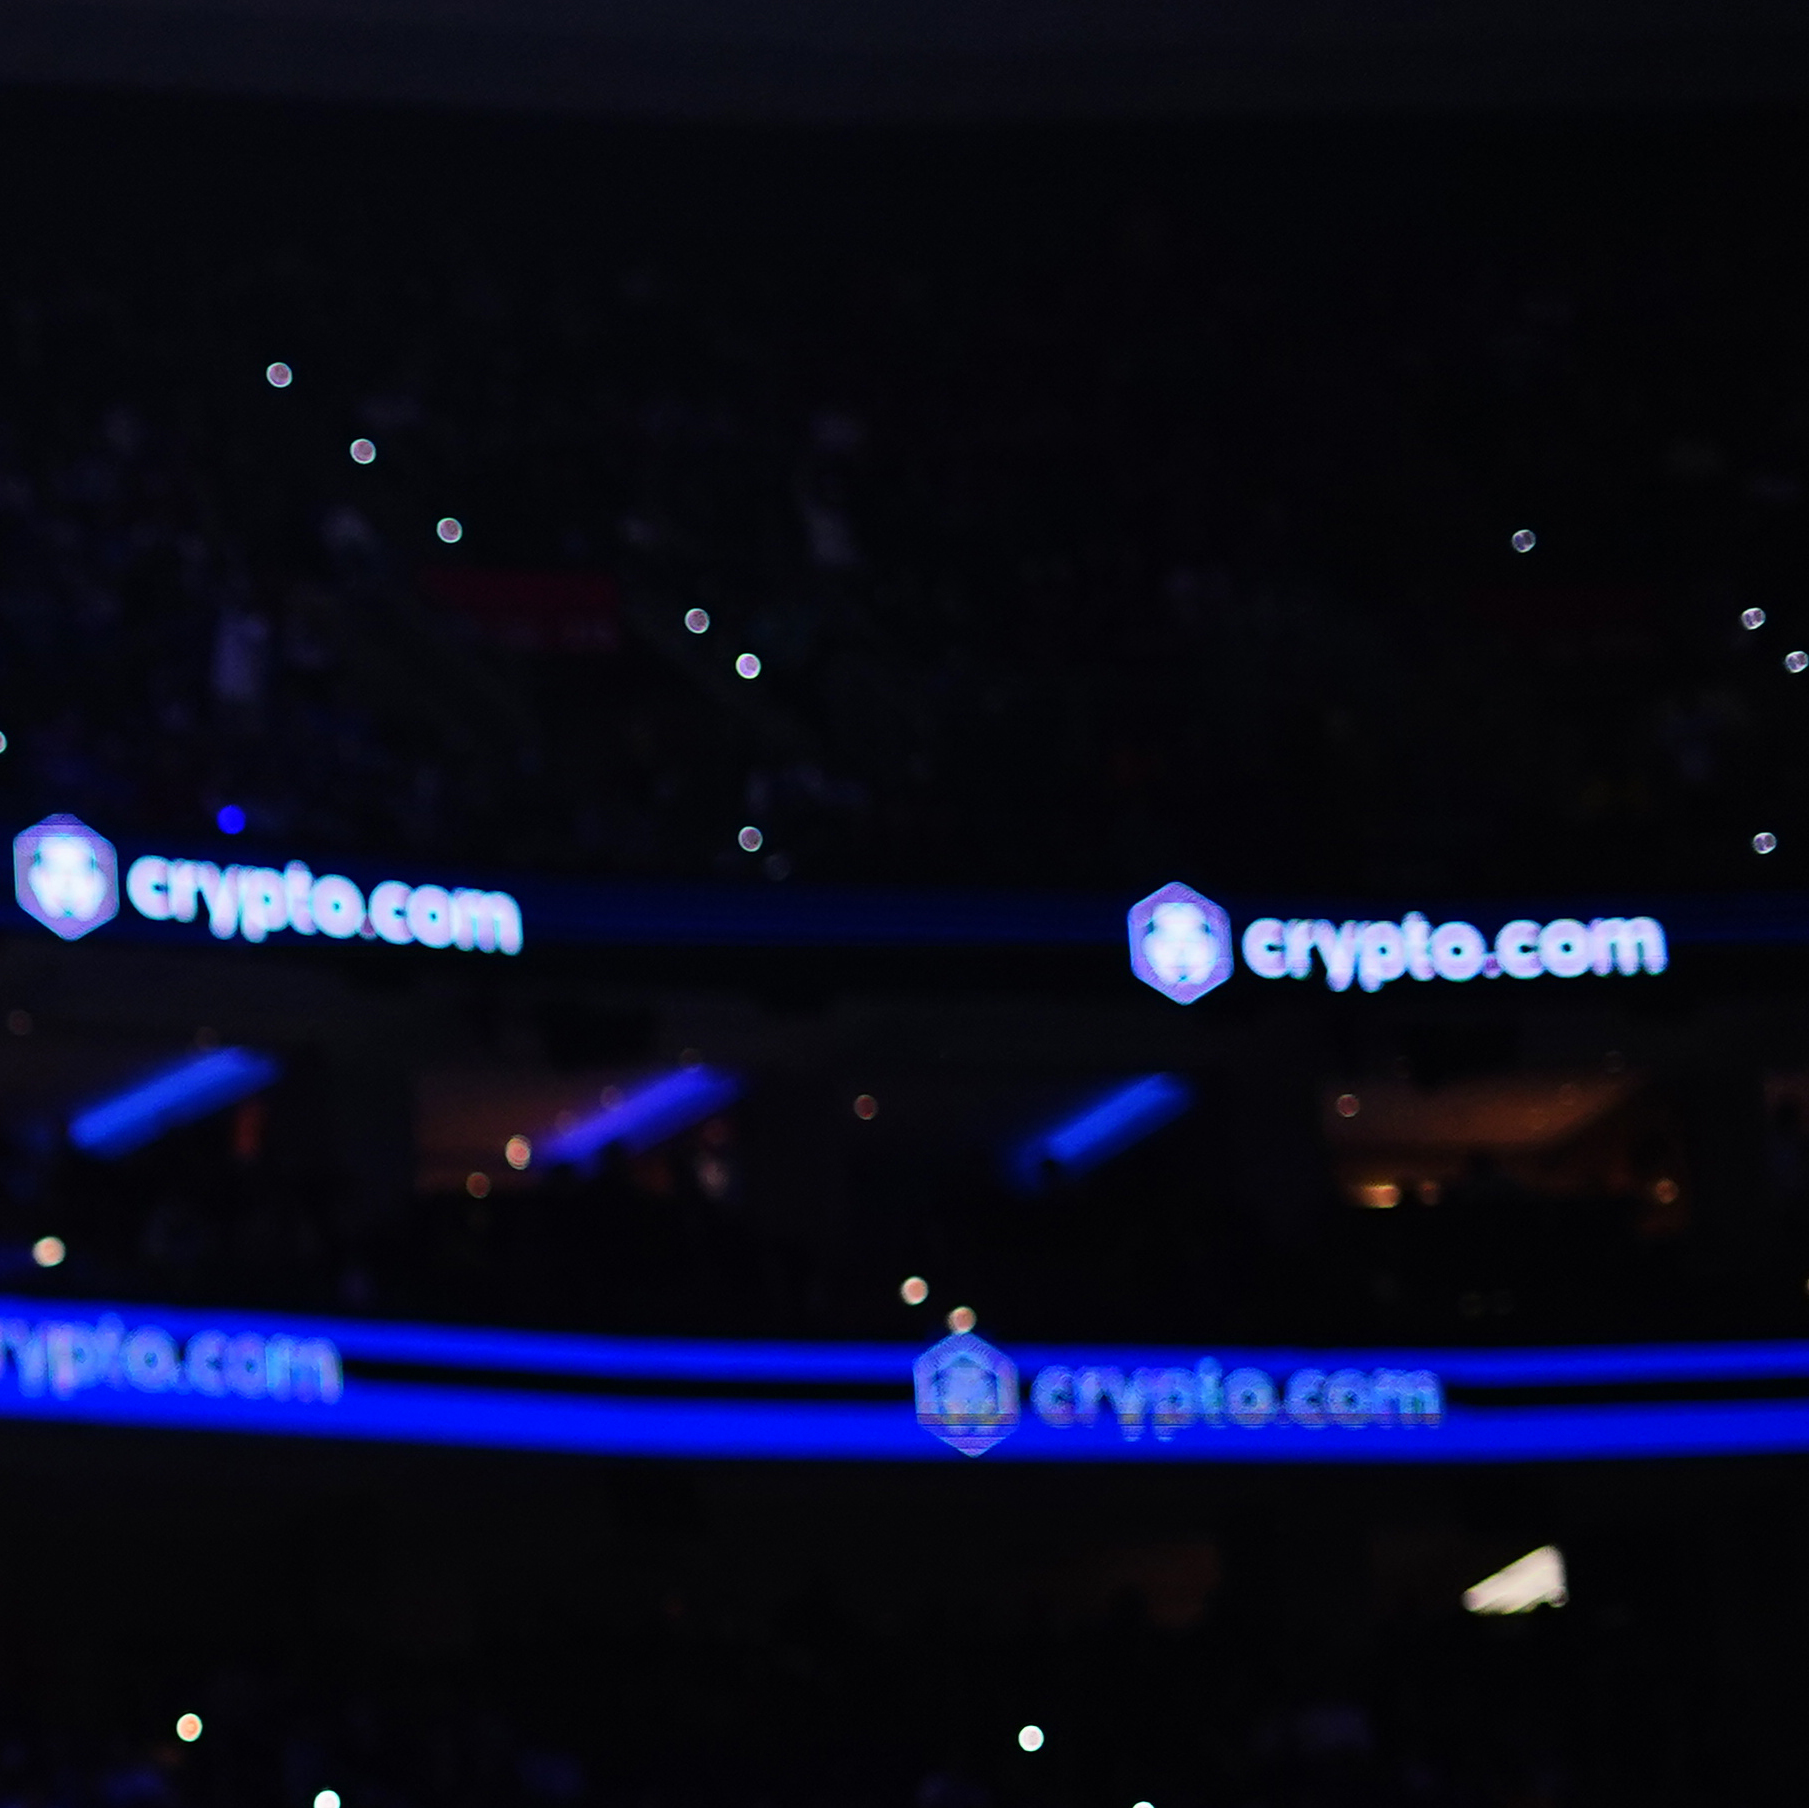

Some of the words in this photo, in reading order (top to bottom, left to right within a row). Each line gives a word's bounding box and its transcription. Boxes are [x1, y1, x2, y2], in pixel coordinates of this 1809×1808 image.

[127, 855, 523, 955] crypto.com
[1242, 911, 1668, 993] crypto.com
[1030, 1356, 1442, 1442] crypto.com
